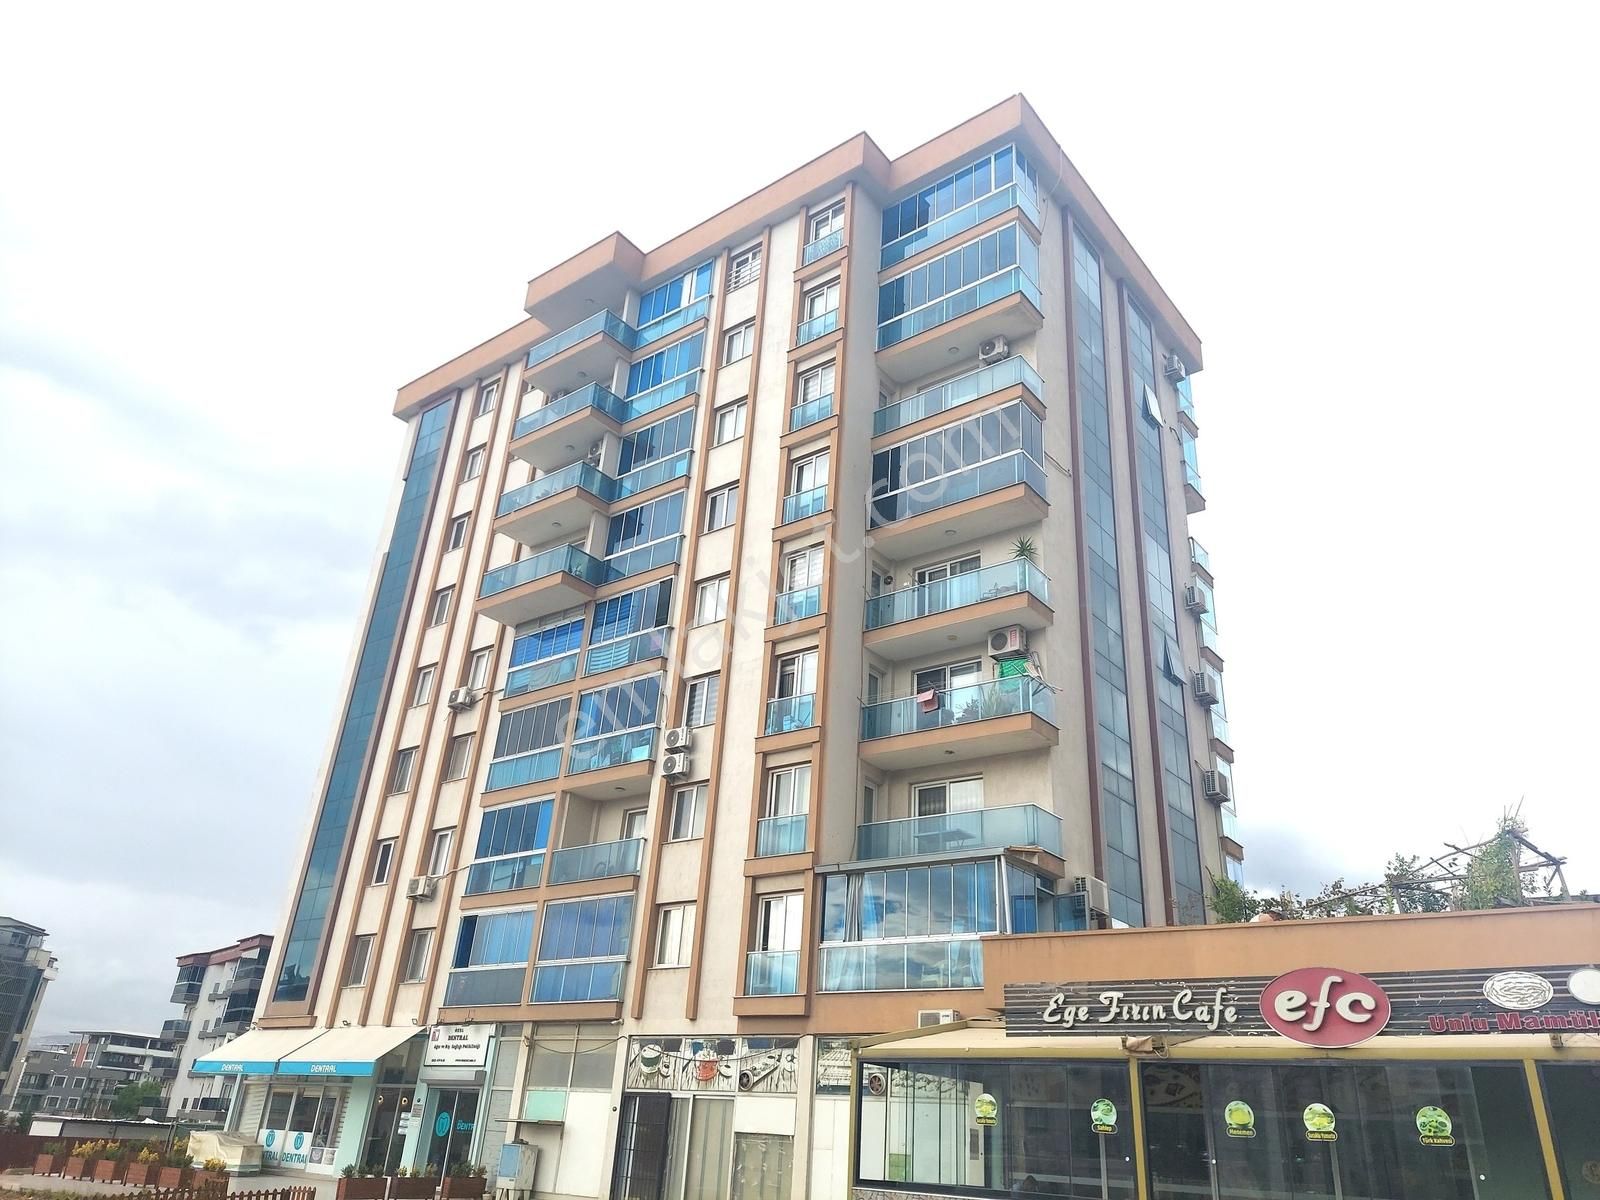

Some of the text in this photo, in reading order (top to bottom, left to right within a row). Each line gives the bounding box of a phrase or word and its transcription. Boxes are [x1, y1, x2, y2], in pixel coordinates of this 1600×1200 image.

[1043, 992, 1090, 1028] Ege
[1274, 975, 1376, 1032] efc
[1428, 1009, 1600, 1033] Unlu Mamül
[221, 1064, 244, 1072] DENTRAL
[310, 1064, 337, 1073] DENTRAL
[456, 1121, 476, 1131] DENTR
